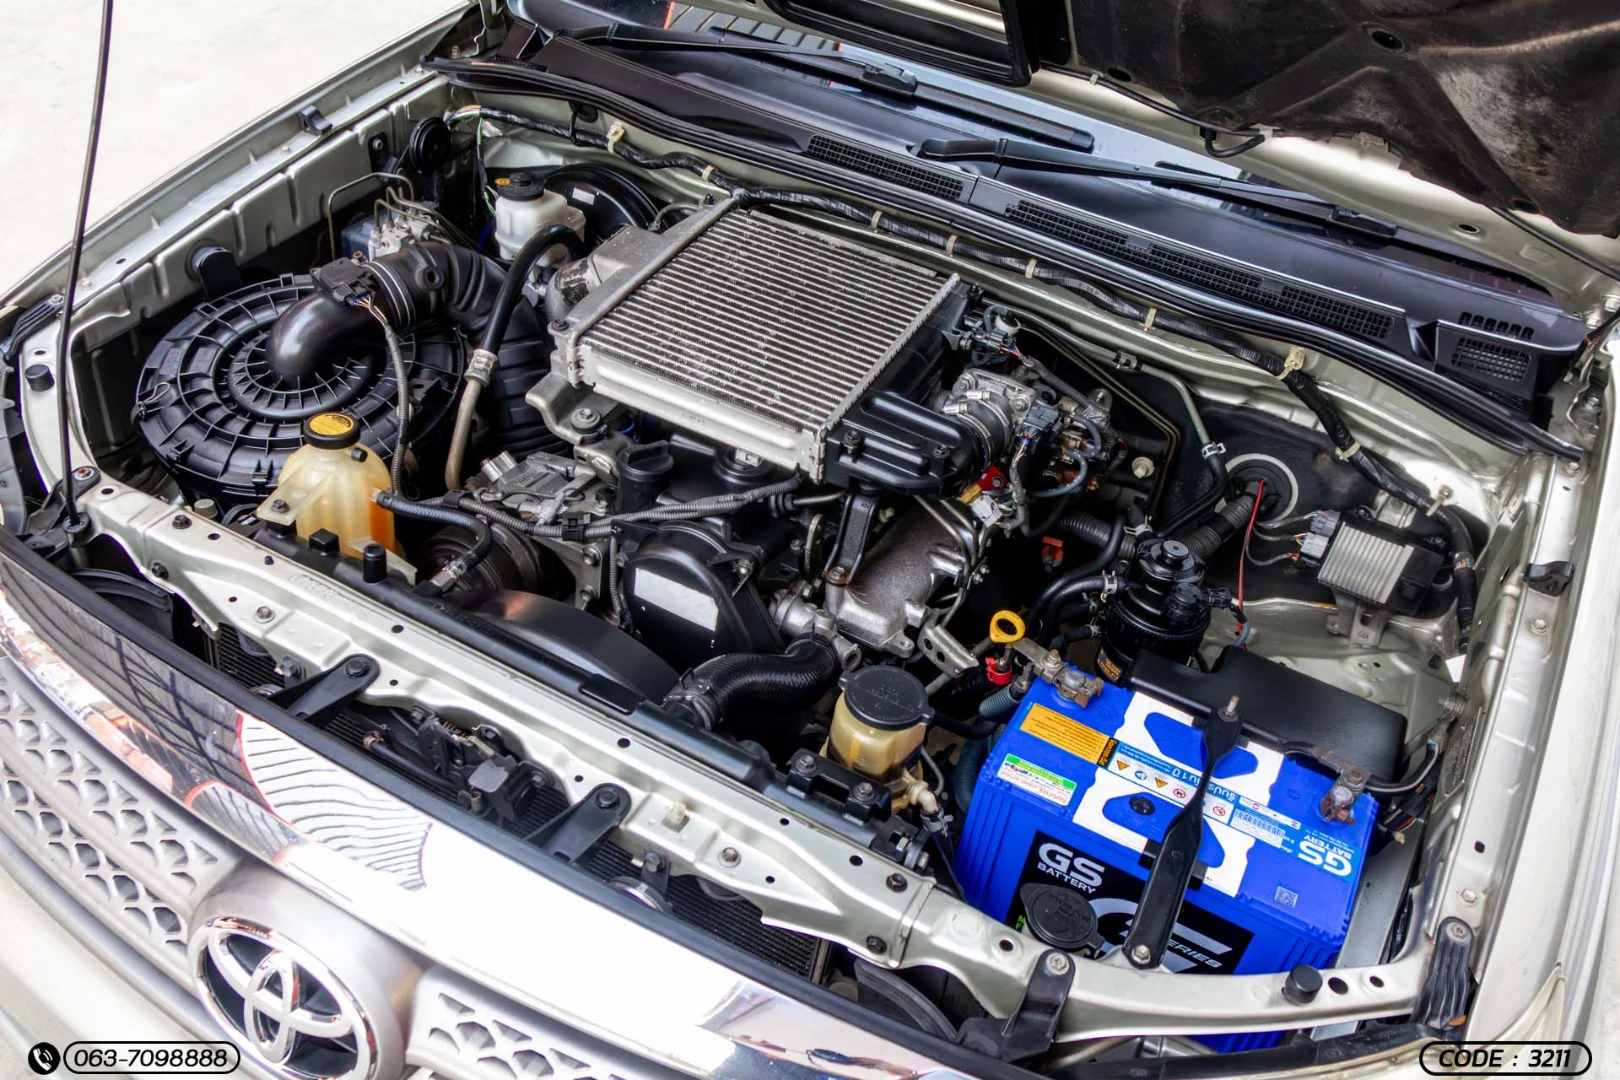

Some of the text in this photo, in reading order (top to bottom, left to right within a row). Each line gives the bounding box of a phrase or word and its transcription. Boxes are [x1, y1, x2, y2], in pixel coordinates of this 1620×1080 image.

[1298, 840, 1352, 877] GS
[1303, 834, 1352, 860] BATTERY
[1037, 861, 1096, 894] BATTERY
[1038, 843, 1105, 887] GS
[1166, 938, 1223, 968] ERIES
